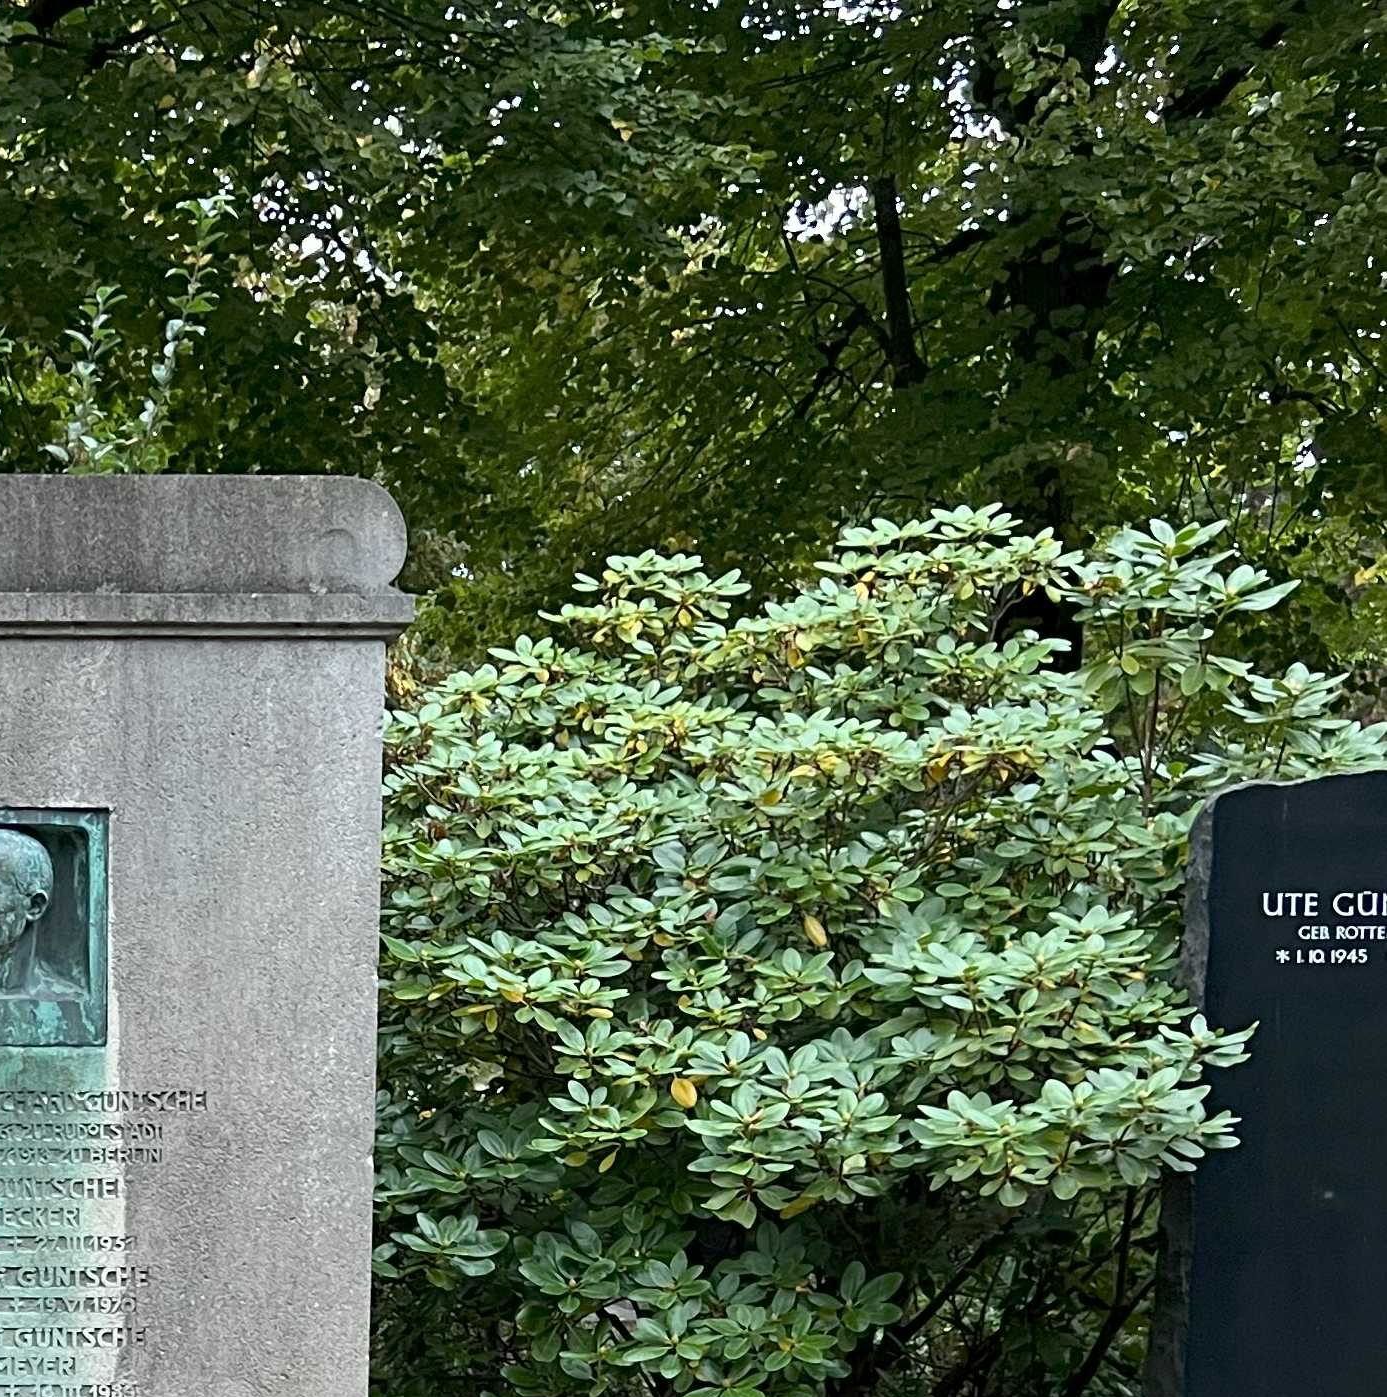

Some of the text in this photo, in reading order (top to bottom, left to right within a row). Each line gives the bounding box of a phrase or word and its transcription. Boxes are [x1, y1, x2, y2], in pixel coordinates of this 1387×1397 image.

[1263, 890, 1387, 917] UTE GÜ
[1336, 925, 1387, 940] ROTTE
[1331, 948, 1368, 964] 1945
[90, 1148, 163, 1164] BERLIN
[15, 1328, 146, 1348] GÜNTSCHE
